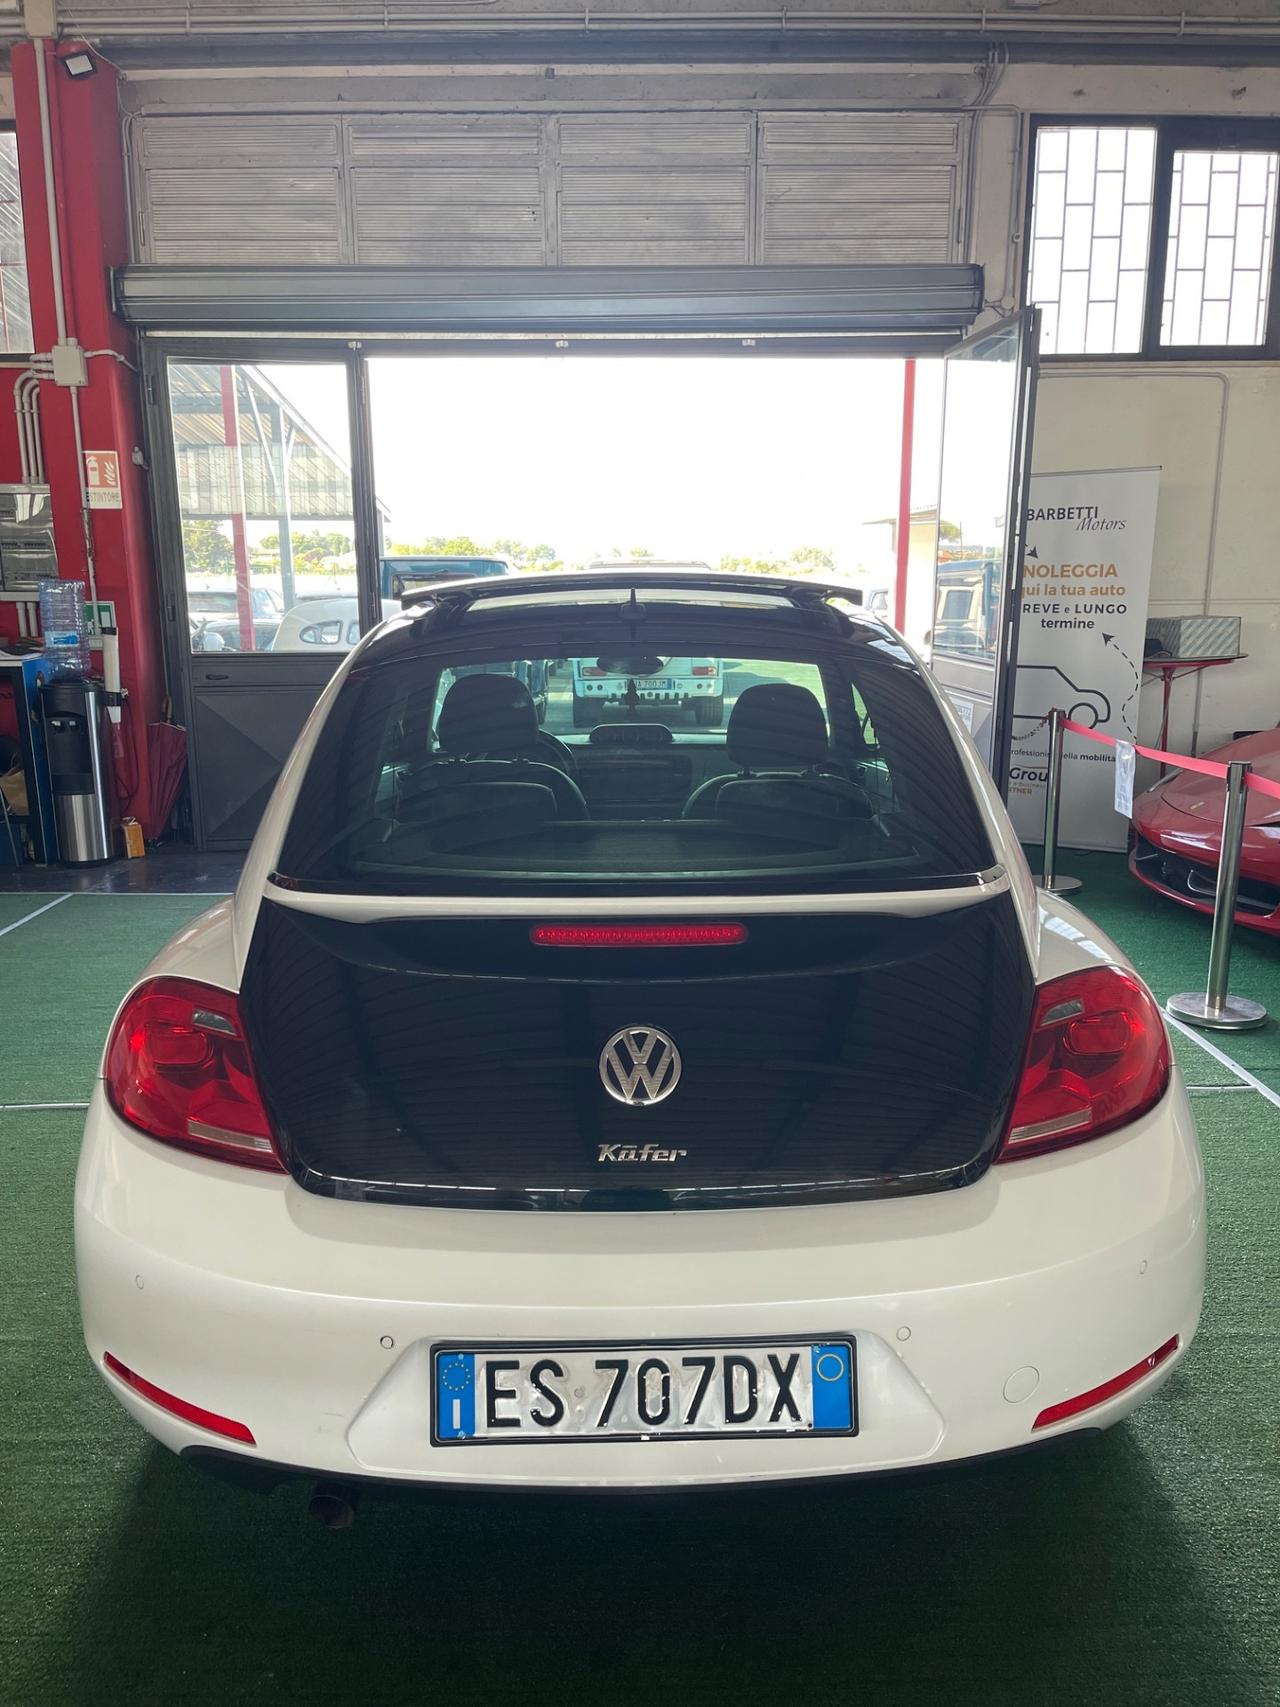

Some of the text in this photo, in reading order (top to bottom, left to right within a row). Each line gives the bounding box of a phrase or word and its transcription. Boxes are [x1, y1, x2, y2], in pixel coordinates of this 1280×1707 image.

[1027, 506, 1098, 521] BARBETTI
[1076, 518, 1127, 531] Motors
[1023, 564, 1118, 578] NOLEGGIA
[1044, 584, 1057, 596] la
[1061, 585, 1086, 596] tua
[1089, 584, 1126, 596] auto
[1022, 603, 1060, 614] REVE
[1075, 604, 1127, 615] LUNGO
[1041, 617, 1095, 629] termine
[1009, 767, 1048, 782] Grou
[598, 1026, 682, 1106] VW
[485, 1353, 802, 1428] ES 707DX
